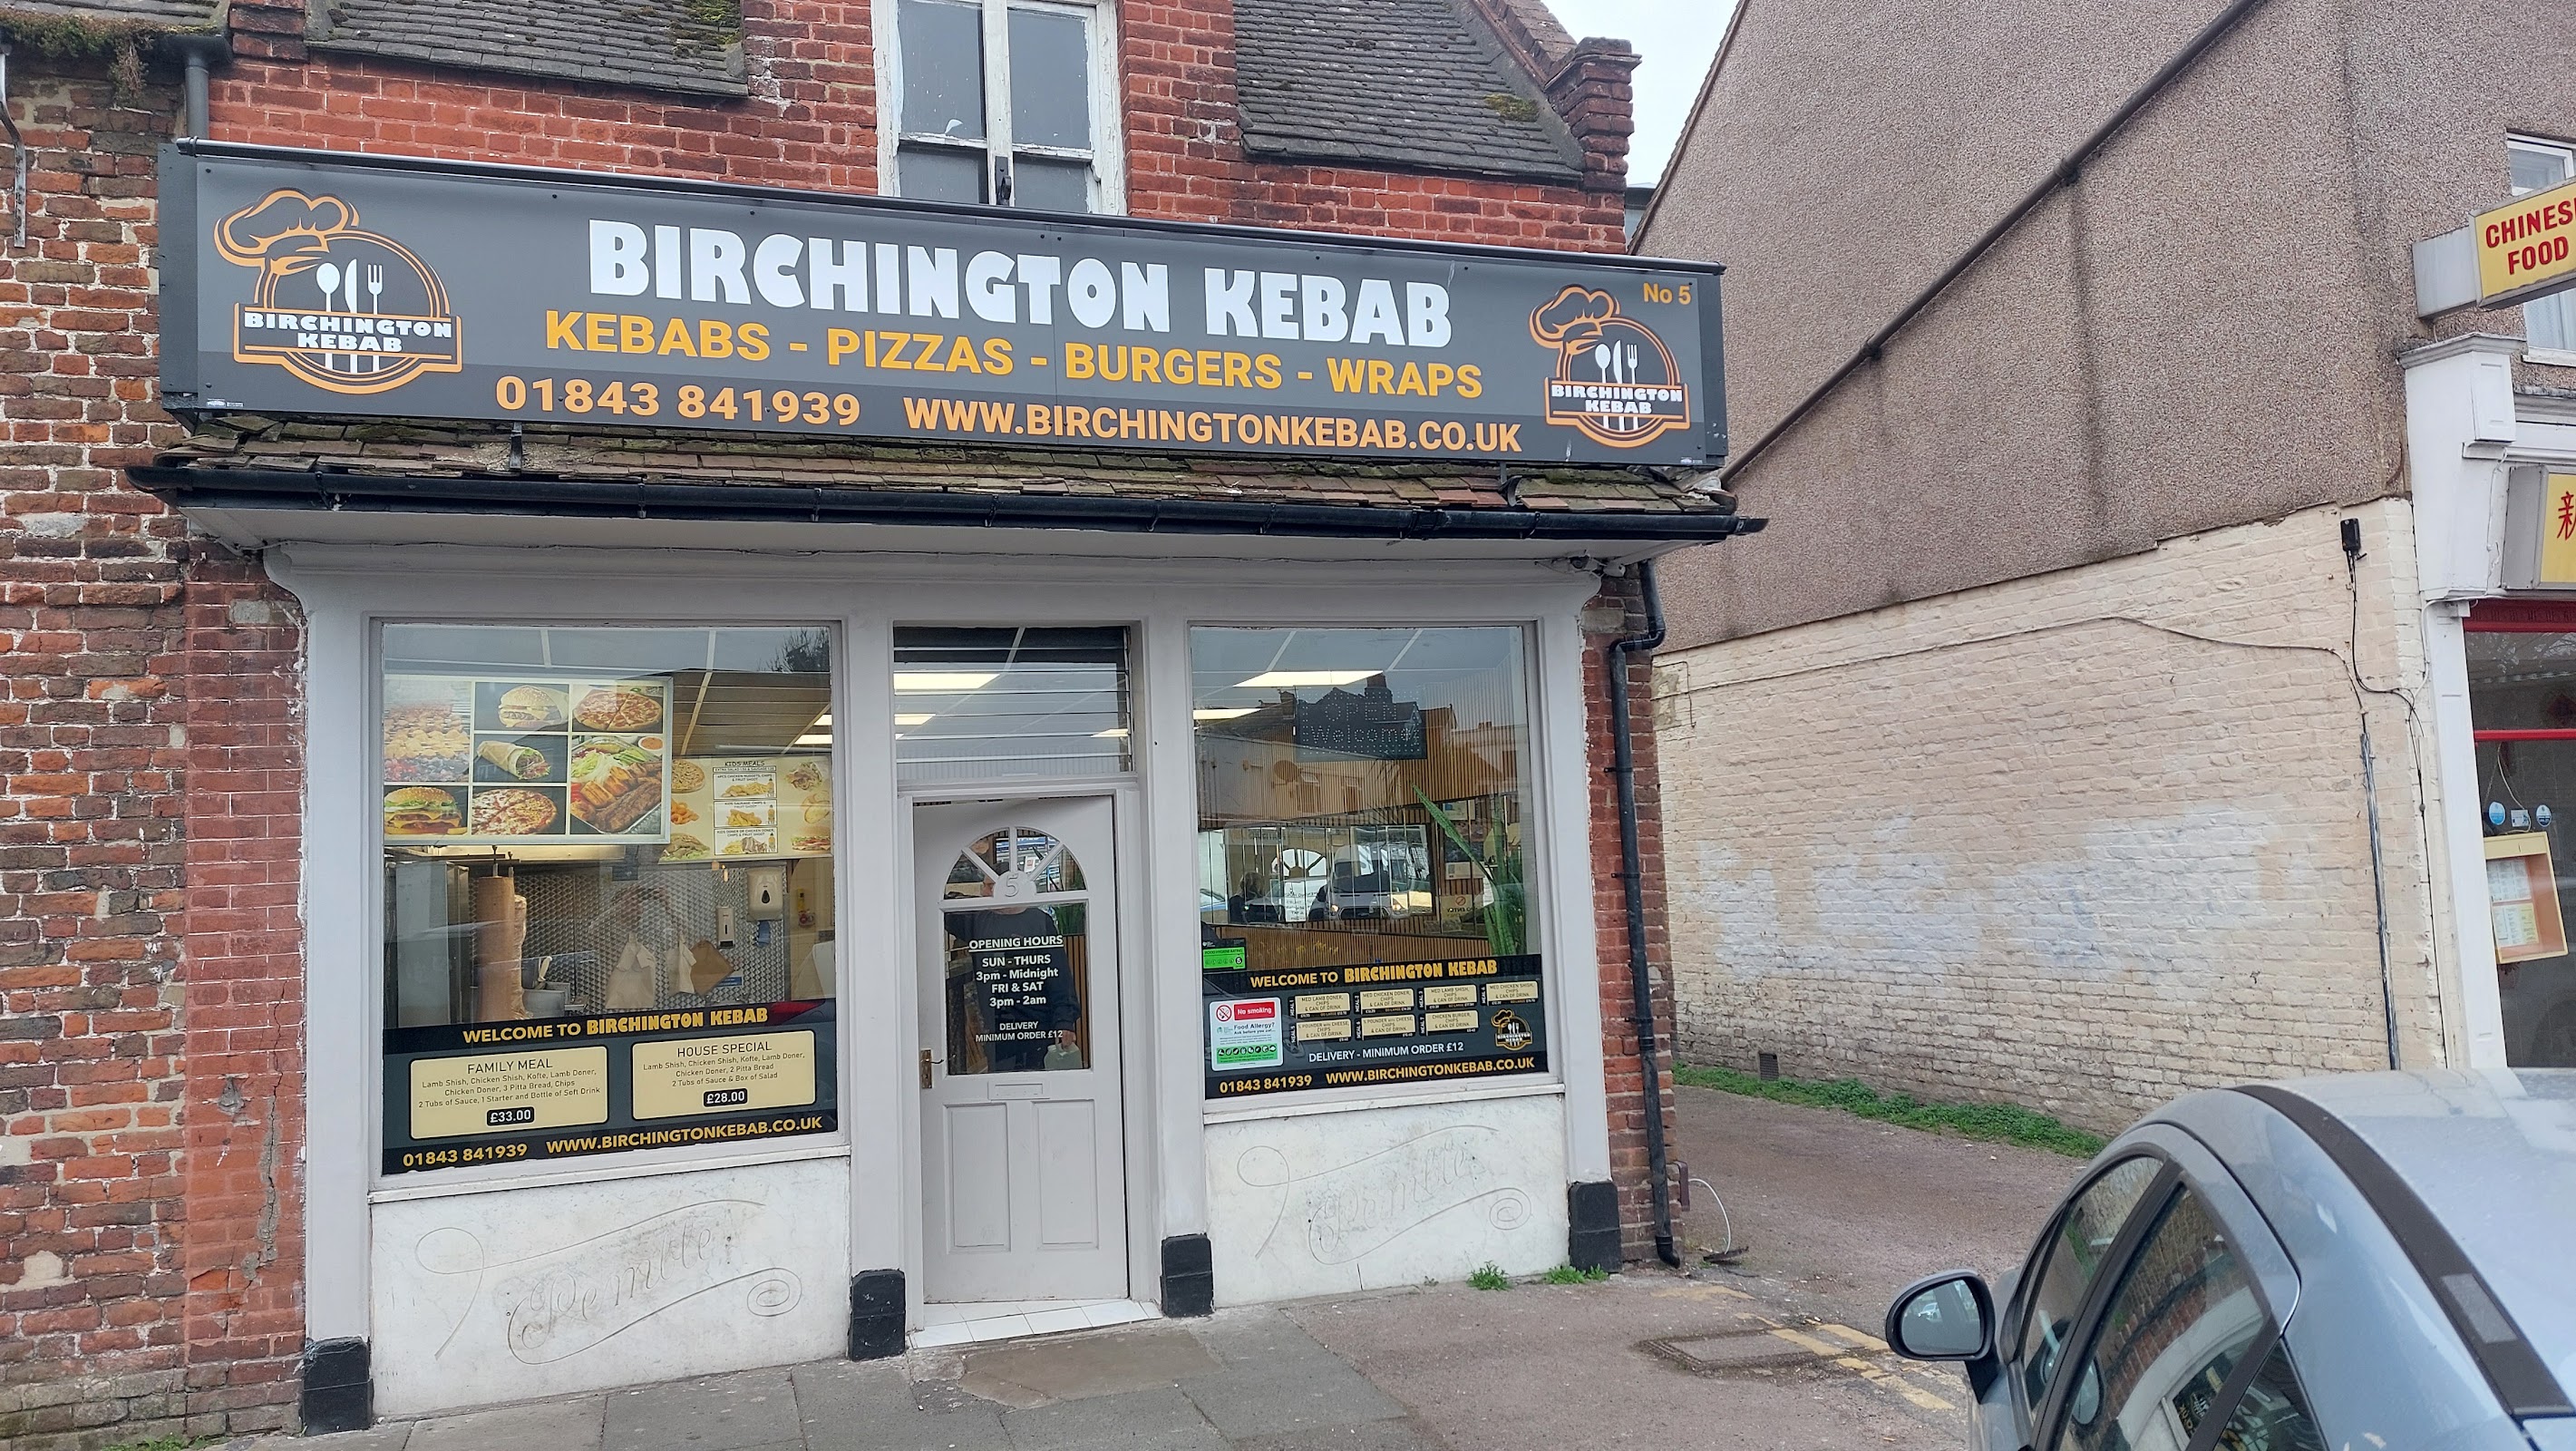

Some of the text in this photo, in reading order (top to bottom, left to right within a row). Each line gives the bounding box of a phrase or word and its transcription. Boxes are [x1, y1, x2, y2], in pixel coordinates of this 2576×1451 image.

[2486, 197, 2576, 248] CHINES
[2508, 236, 2569, 276] FOOD
[589, 219, 1452, 348] BIRCHINGTON KEBAB
[1643, 282, 1692, 306] No 5
[244, 312, 453, 339] BIRCHINGTON
[296, 332, 403, 354] KEBAB
[546, 310, 1483, 399] KEBABS - PIZZAS - BURGERS - WRAPS
[496, 375, 860, 426] 01843 841939
[1550, 384, 1685, 404] BIRCHINGTON
[1585, 399, 1653, 415] KEBAB
[904, 396, 1522, 453] WWW.BIRCHINGTONKEBAB.CO.UK
[1325, 701, 1397, 723] OPEN
[1311, 726, 1412, 745] Welcome
[1005, 873, 1019, 897] 5
[968, 935, 1064, 950] OPENING HOURS
[982, 957, 1006, 968] SUN
[1014, 954, 1051, 966] THURS
[976, 971, 1000, 983] 3pm
[1009, 968, 1058, 980] Midnight
[1250, 959, 1497, 988] WELCOME TO BIRCHINGTON KEBAB
[991, 981, 1045, 994] FRI & SAT
[989, 997, 1014, 1009] 3pm
[1024, 996, 1046, 1005] 2am
[1247, 1007, 1271, 1015] smoking
[462, 1008, 768, 1044] WELCOME TO BIRCHINGTON KEBAB
[999, 1021, 1038, 1030] DELIVERY
[1250, 1022, 1275, 1030] Allergy?
[976, 1030, 1063, 1042] MINIMUM ORDER £12
[677, 1041, 773, 1058] HOUSE SPECIAL
[1308, 1049, 1356, 1063] DELIVERY
[1362, 1046, 1409, 1059] MINIMUM
[1411, 1043, 1444, 1056] ORDER
[1446, 1041, 1464, 1053] £12
[467, 1058, 553, 1075] FAMILY MEAL
[643, 1051, 805, 1071] Lamb Shish, Chicken Shish, Kofte, Lamb Doner,
[676, 1068, 704, 1077] Chicken
[705, 1066, 728, 1076] Doner,
[736, 1064, 752, 1073] Pitta
[753, 1063, 774, 1071] Bread
[1326, 1057, 1535, 1085] WWW.BIRCHINGTONKEBAB.CO.UK
[422, 1068, 597, 1088] Lamb Shish, Chicken Shish, Kofte, Lamb Doner,
[444, 1079, 576, 1096] Chicken Doner, 3 Pitta Bread, Chips
[678, 1078, 695, 1086] Tubs
[696, 1077, 704, 1086] of
[705, 1076, 726, 1085] Sauce
[735, 1074, 749, 1082] Box
[750, 1073, 757, 1081] of
[759, 1072, 778, 1080] Salad
[1220, 1075, 1312, 1094] 01843 841939
[425, 1099, 443, 1107] Tubs
[445, 1098, 452, 1106] of
[454, 1096, 480, 1105] Sauce,
[487, 1094, 513, 1103] Starter
[515, 1093, 529, 1101] and
[530, 1090, 553, 1099] Bottle
[555, 1089, 562, 1097] of
[564, 1087, 579, 1096] Soft
[581, 1086, 600, 1096] Drink
[706, 1091, 745, 1105] £28.00
[490, 1109, 531, 1124] £33.00
[546, 1116, 822, 1154] WWW.BIRCHINGTONKEBAB.CO.UK
[403, 1143, 528, 1168] 01843 841939
